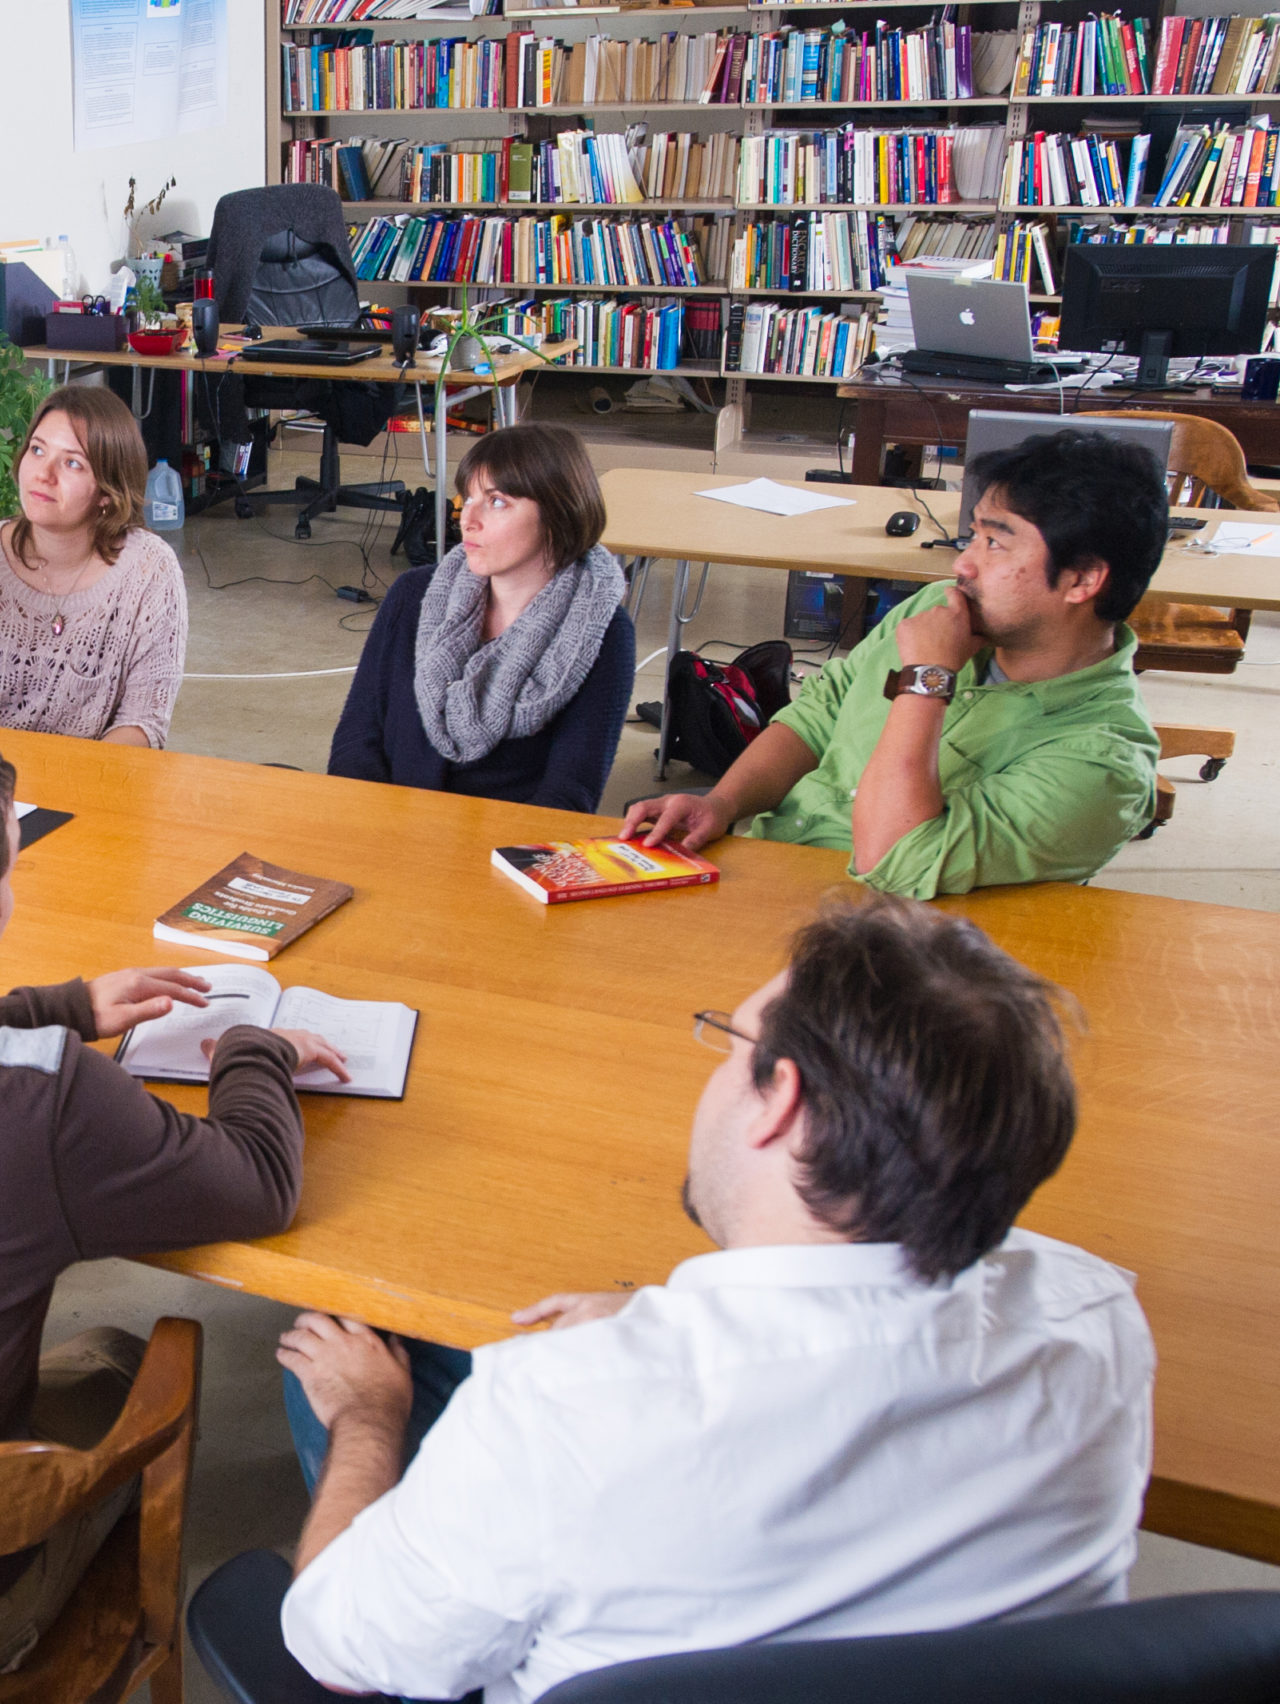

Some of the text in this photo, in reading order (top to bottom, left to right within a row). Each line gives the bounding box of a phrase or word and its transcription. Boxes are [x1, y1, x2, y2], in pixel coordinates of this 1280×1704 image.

[791, 230, 799, 274] DICTIONARY
[798, 230, 808, 273] ENCARTA
[213, 891, 254, 907] Students
[222, 901, 237, 909] for
[238, 906, 266, 915] Guide
[187, 911, 271, 935] SURVIVING
[191, 902, 285, 930] LINGUISTICS
